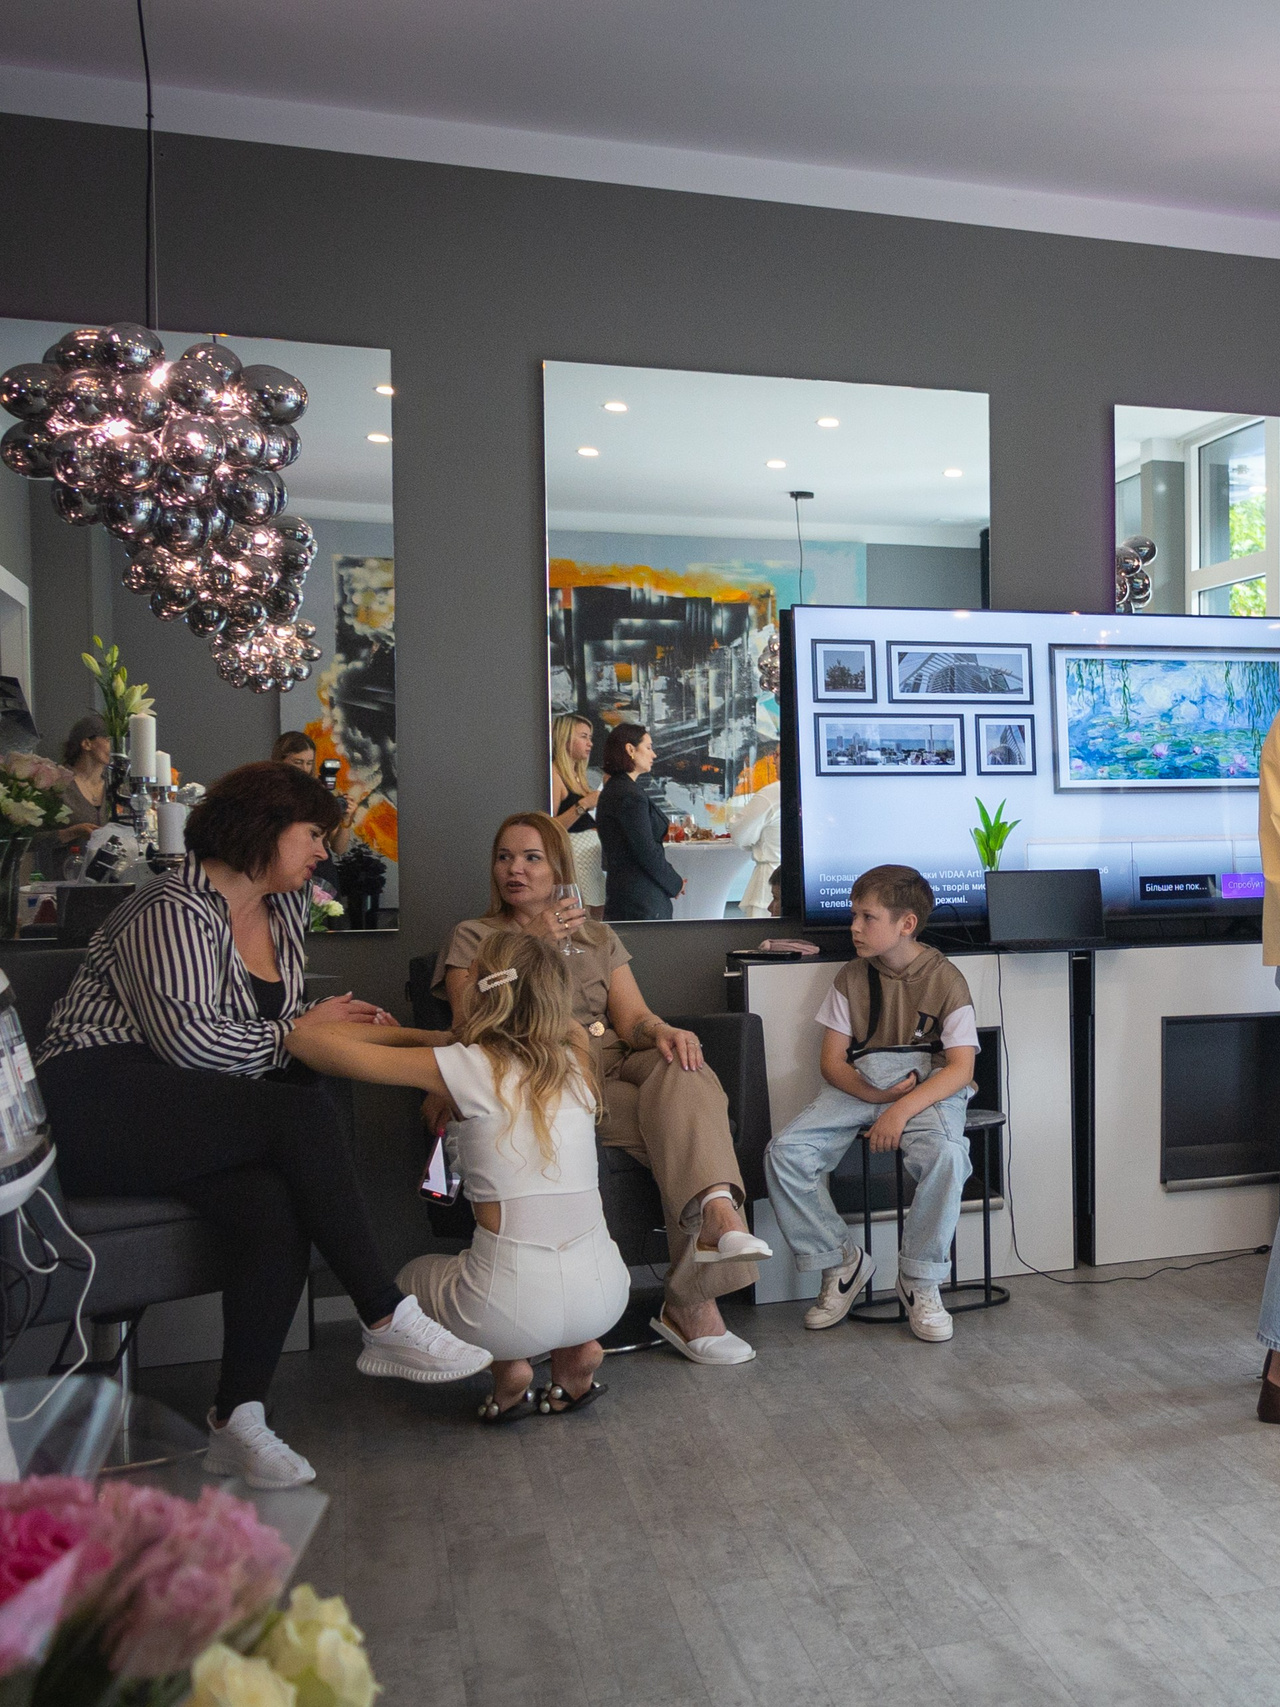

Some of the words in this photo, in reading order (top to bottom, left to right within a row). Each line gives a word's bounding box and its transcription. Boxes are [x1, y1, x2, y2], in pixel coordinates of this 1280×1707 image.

[819, 873, 860, 884] Покращт
[938, 869, 965, 879] VIDAA
[966, 869, 983, 878] Art!
[819, 887, 852, 896] отрима
[942, 882, 970, 893] творів
[1145, 883, 1174, 892] Більше
[1174, 883, 1185, 891] не
[819, 899, 853, 908] телевіз
[935, 895, 968, 906] режимі.
